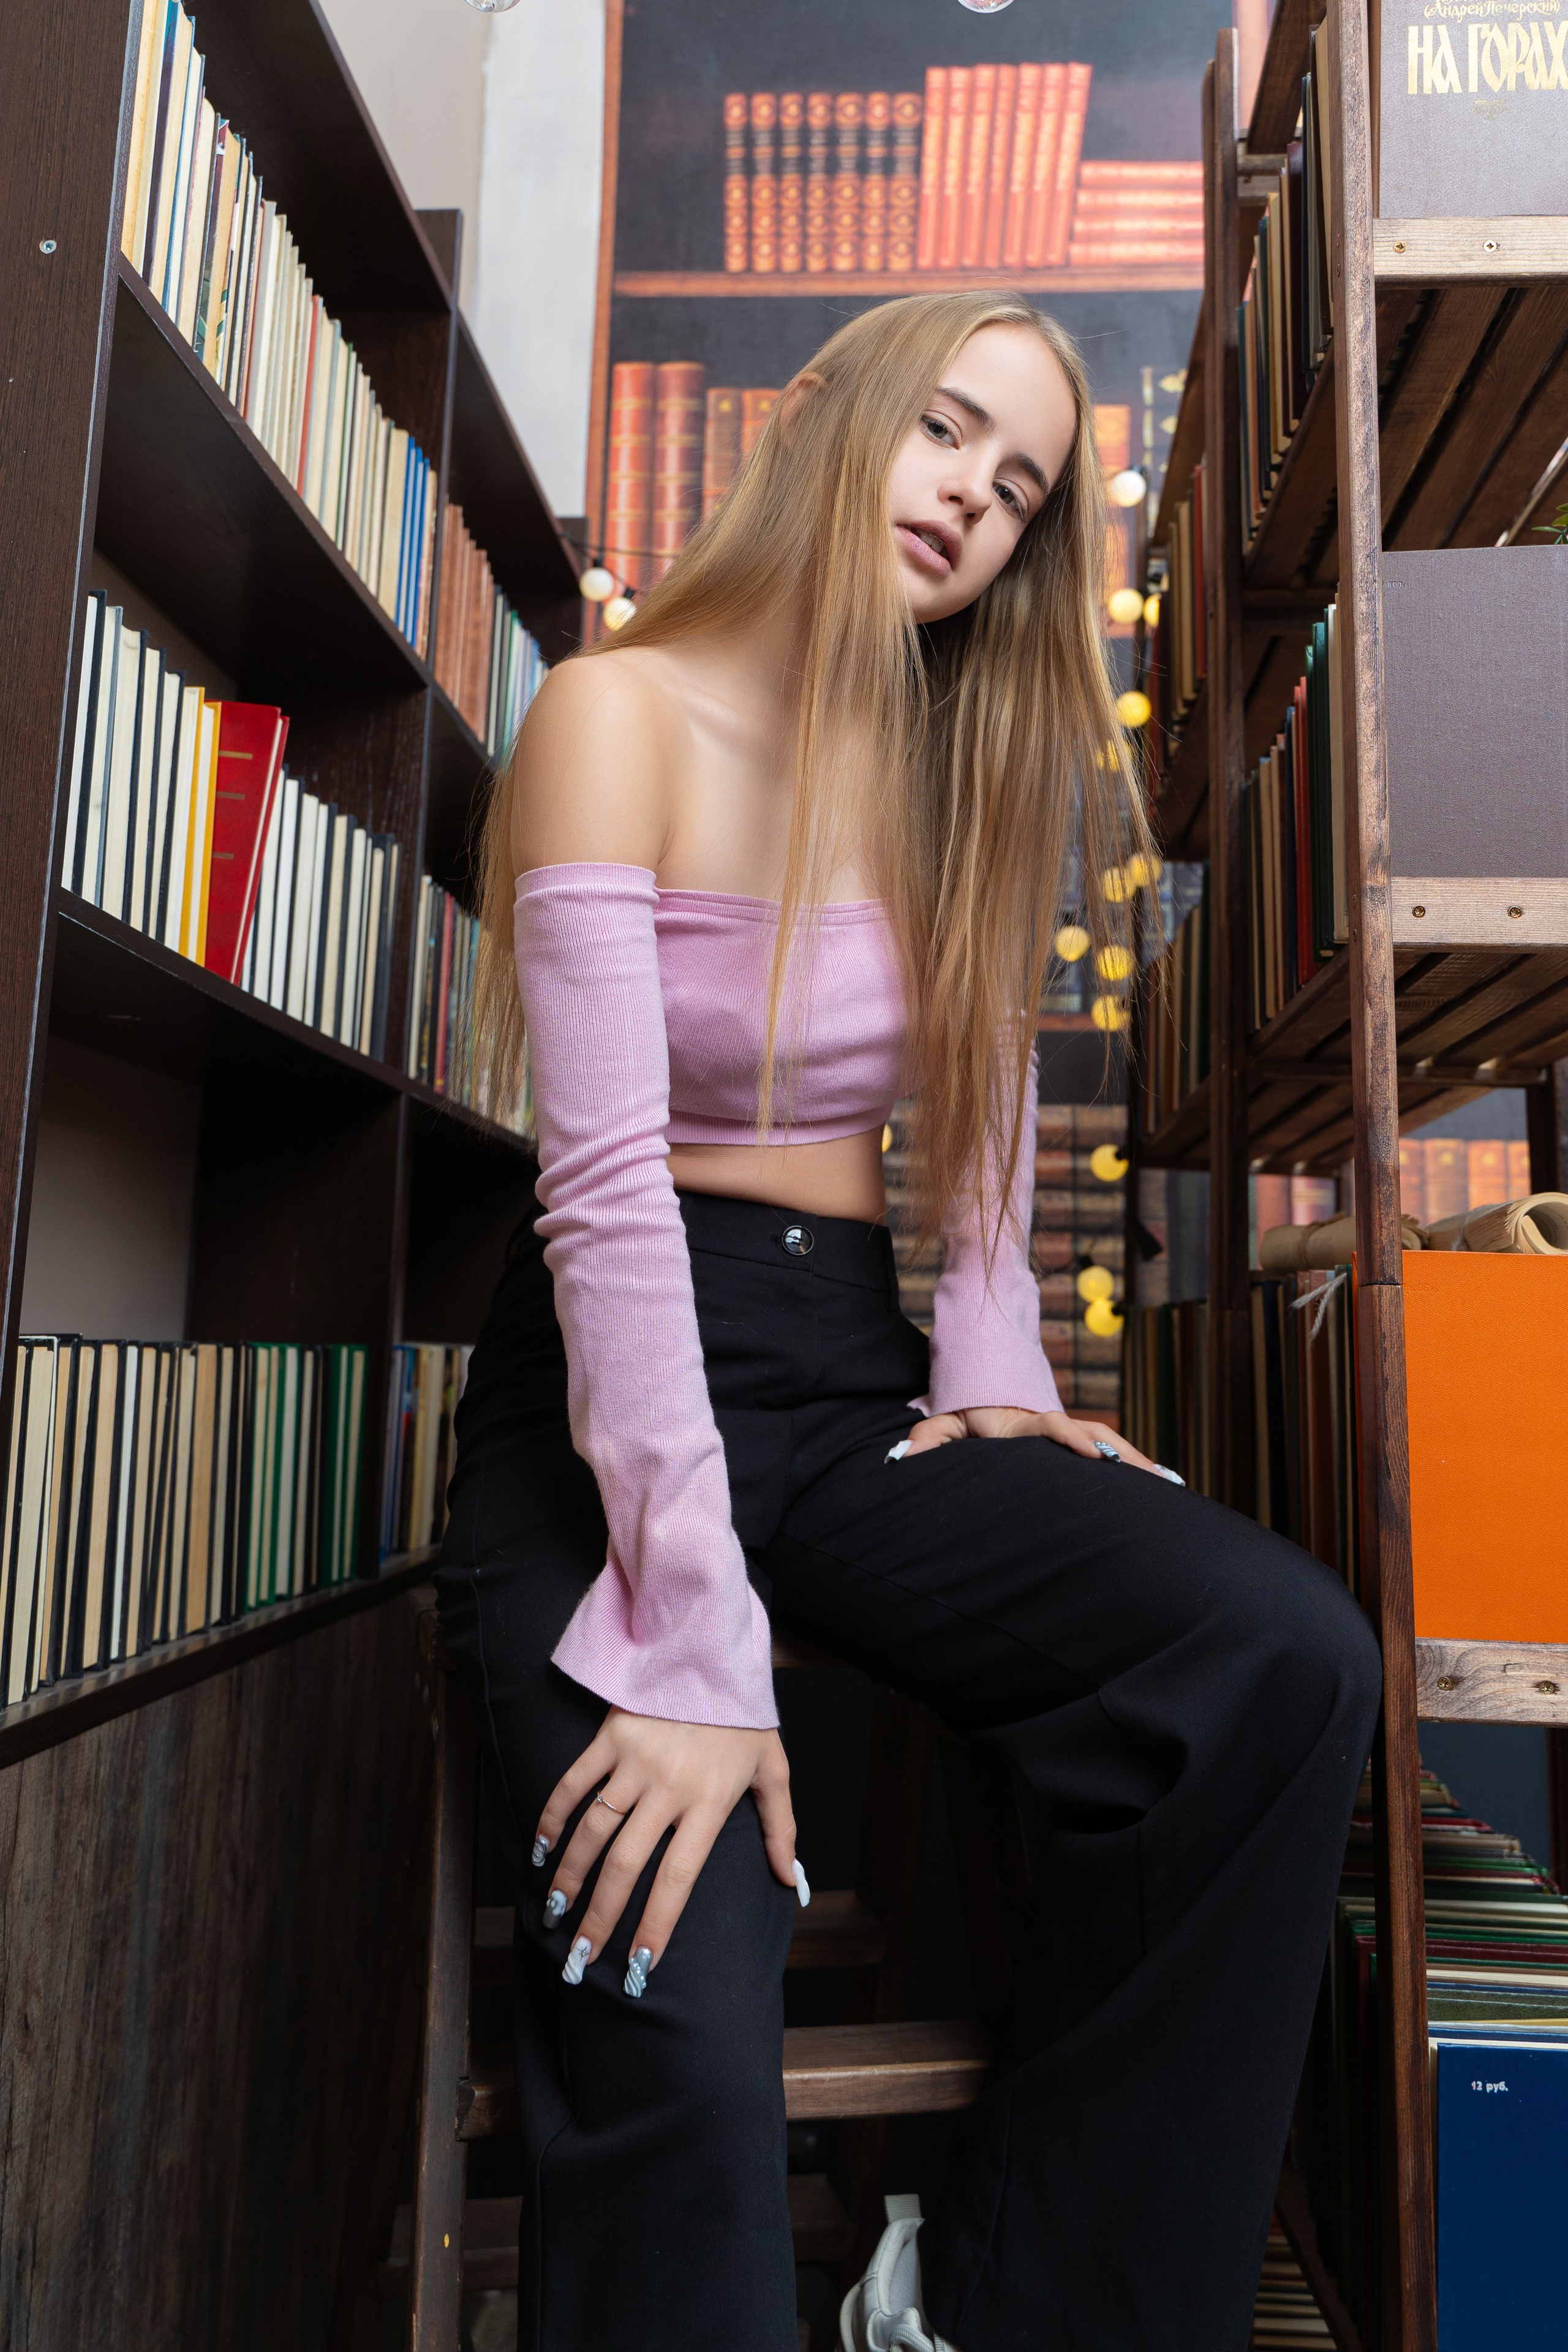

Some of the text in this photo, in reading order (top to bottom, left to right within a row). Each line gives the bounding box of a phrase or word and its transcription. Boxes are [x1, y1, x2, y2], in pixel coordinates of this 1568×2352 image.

[1408, 20, 1568, 94] НА ГОРАХ
[1471, 2081, 1509, 2093] 12 руб.
